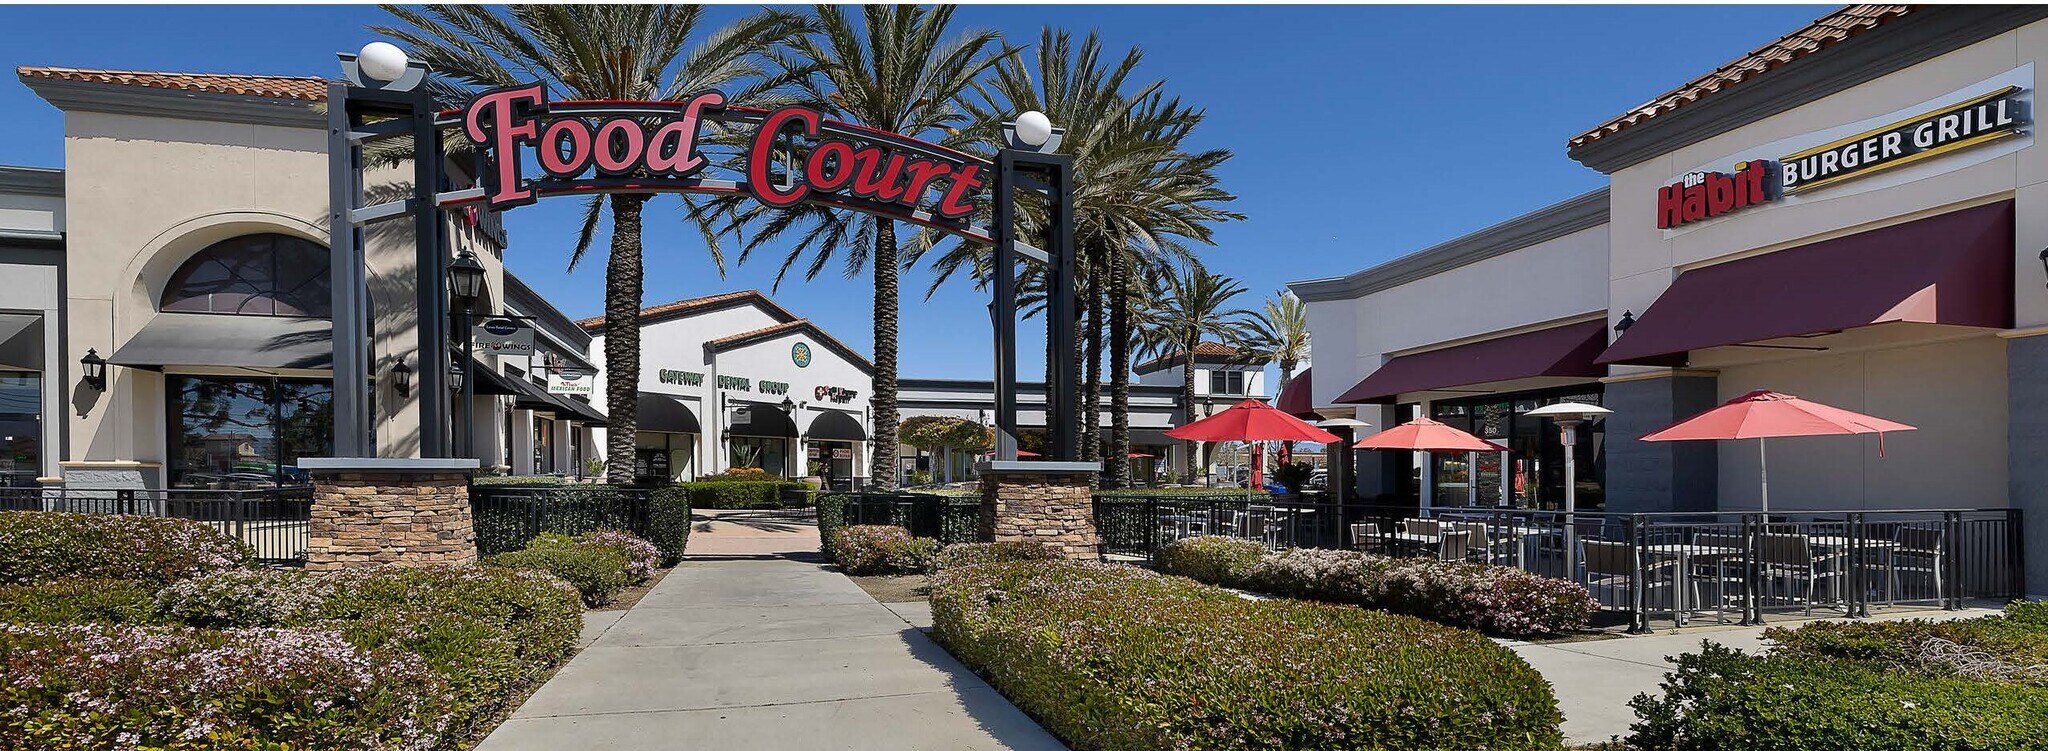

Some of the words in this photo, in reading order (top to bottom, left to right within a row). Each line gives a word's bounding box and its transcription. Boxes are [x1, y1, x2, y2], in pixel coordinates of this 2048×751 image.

[465, 83, 725, 205] Food
[748, 105, 988, 217] Court
[1781, 131, 1902, 187] BURGER
[1912, 99, 2014, 149] GRILL
[1657, 158, 1774, 230] Habit
[1683, 171, 1705, 189] the
[502, 343, 531, 351] WINGS
[659, 369, 705, 386] GATEWAY
[718, 375, 750, 391] DENTAL
[759, 380, 790, 394] GROUP
